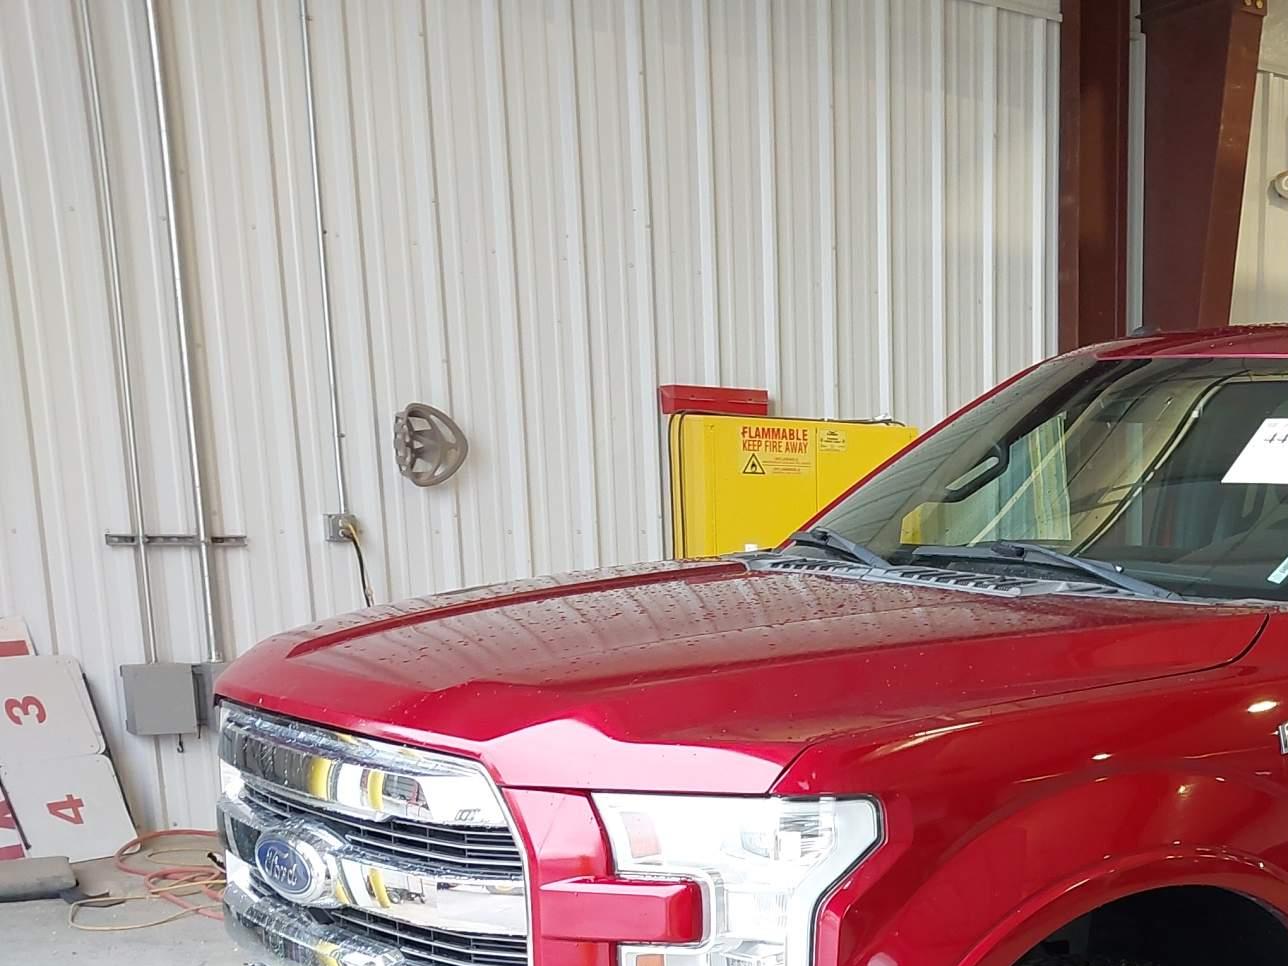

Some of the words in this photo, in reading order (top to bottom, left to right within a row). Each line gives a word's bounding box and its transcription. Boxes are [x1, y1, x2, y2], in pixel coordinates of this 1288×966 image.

[741, 426, 808, 441] FLAMMABLE
[742, 440, 763, 452] KEEP
[764, 441, 783, 453] FIRE
[784, 442, 809, 454] AWAY
[4, 694, 48, 727] 3
[46, 793, 85, 826] 4
[264, 846, 298, 887] Ford
